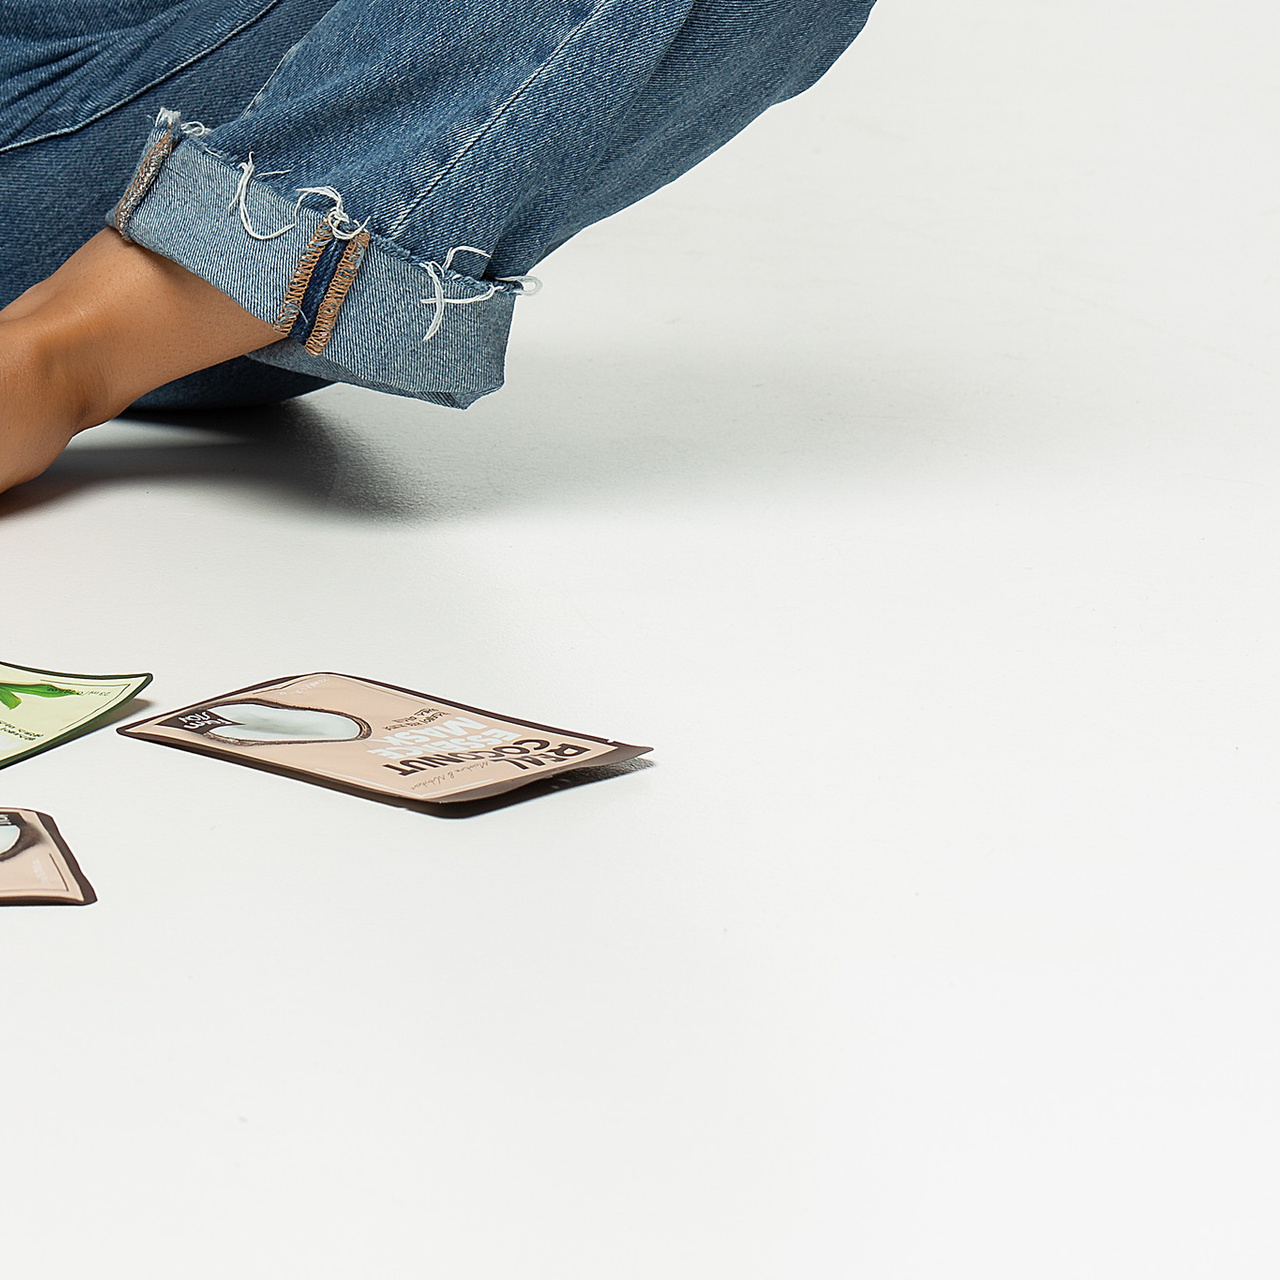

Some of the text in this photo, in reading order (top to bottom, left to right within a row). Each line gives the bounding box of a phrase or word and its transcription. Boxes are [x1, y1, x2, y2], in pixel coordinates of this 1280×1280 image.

[371, 716, 487, 747] MASK
[382, 739, 550, 777] COCONUT
[492, 743, 591, 770] REAL
